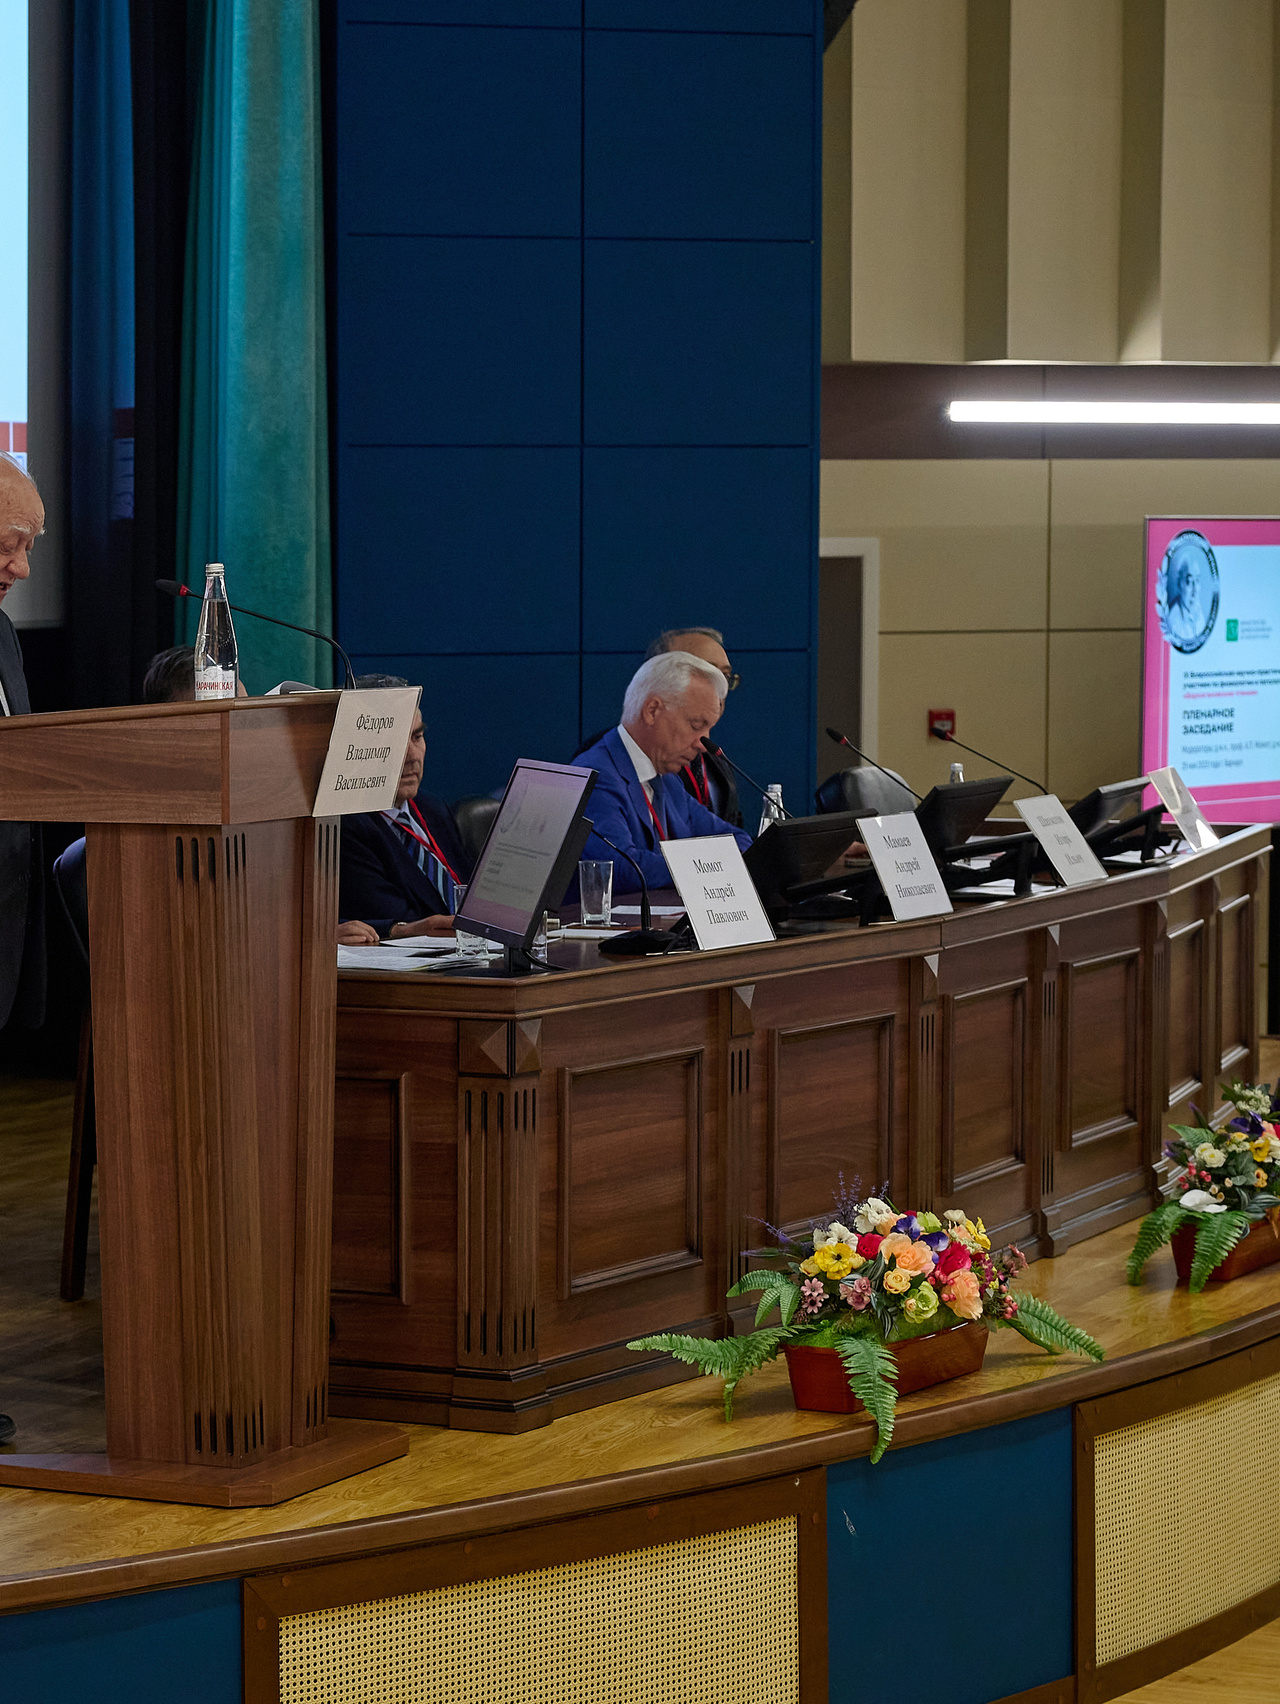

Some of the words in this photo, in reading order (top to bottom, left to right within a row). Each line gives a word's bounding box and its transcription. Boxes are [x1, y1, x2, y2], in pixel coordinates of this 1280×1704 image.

[356, 714, 394, 734] Фёдоров
[346, 744, 390, 763] Владимир
[334, 774, 387, 791] Васильевич
[692, 859, 724, 874] Момот
[895, 857, 921, 875] Андрей
[703, 883, 736, 902] Андрей
[895, 883, 937, 898] Николаевич
[706, 910, 749, 924] Павлович
